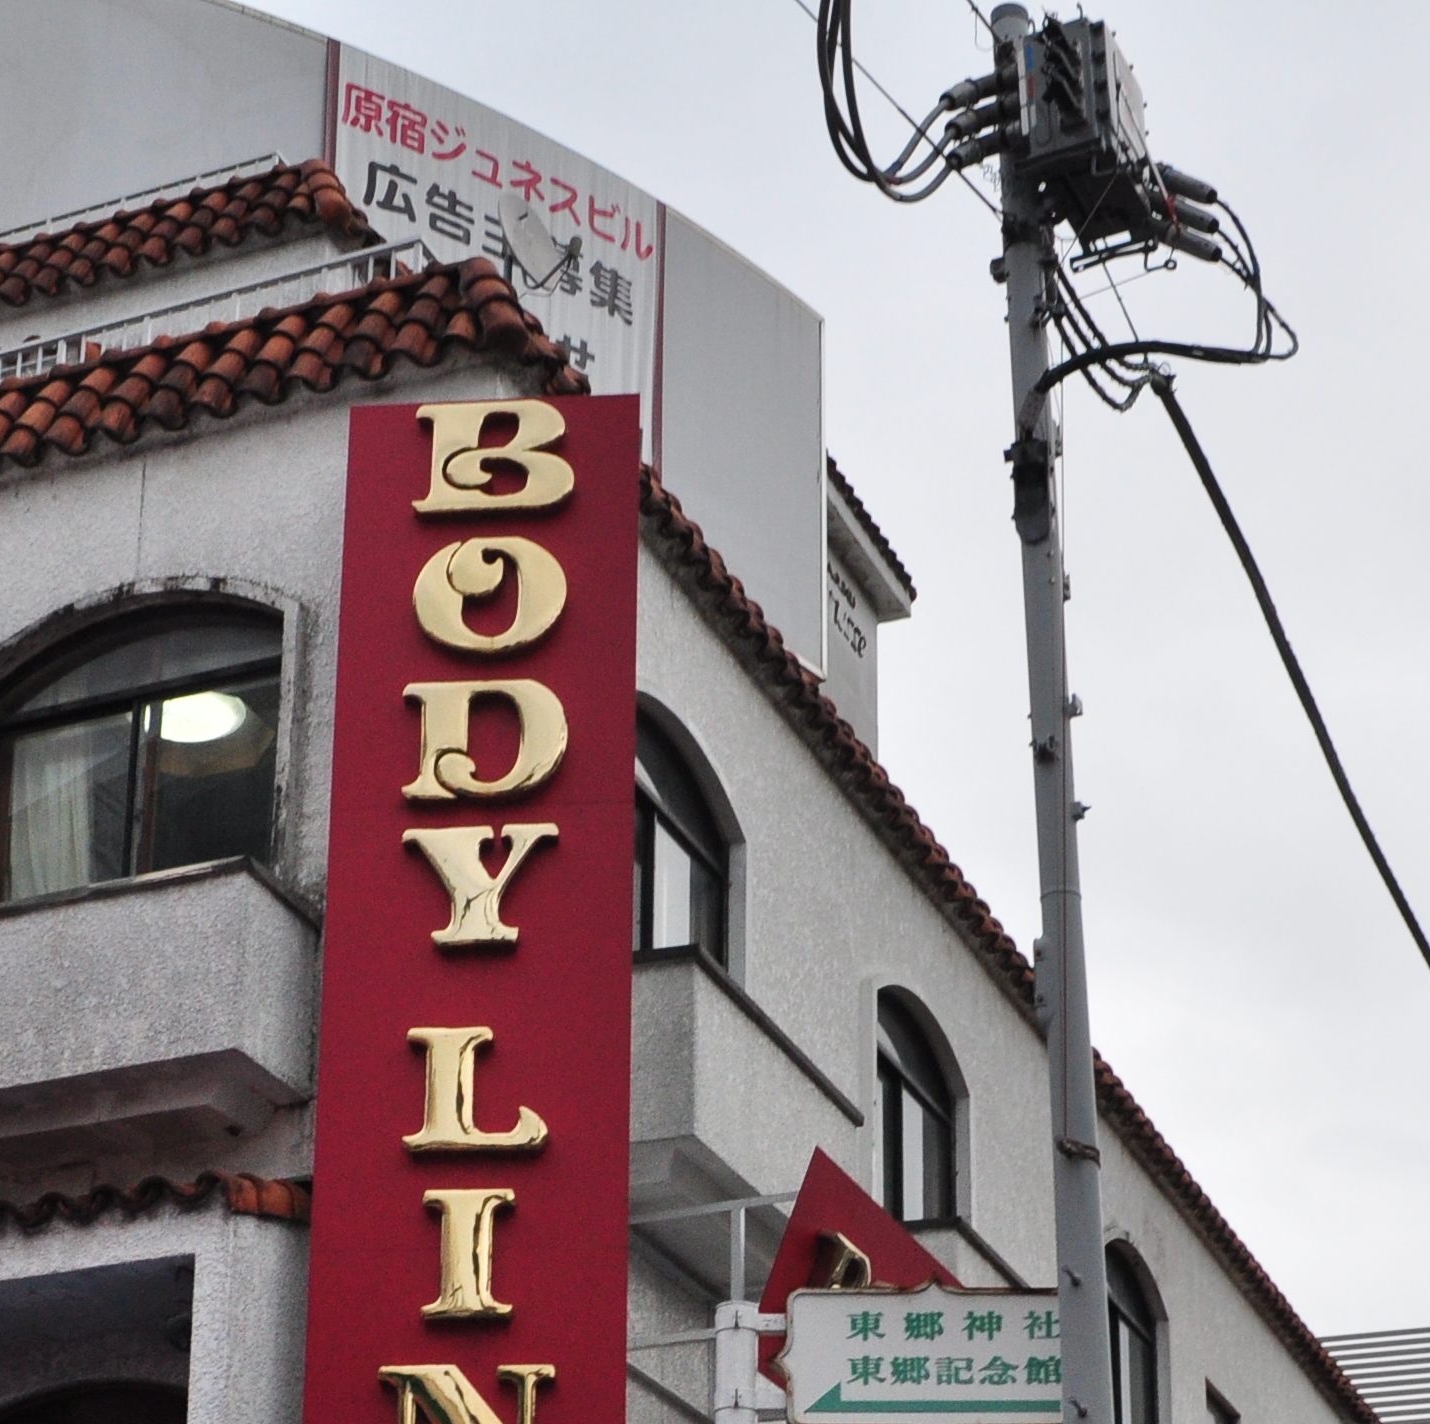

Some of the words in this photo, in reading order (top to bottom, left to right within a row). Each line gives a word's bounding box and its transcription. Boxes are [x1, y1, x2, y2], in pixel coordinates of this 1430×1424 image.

[341, 82, 654, 261] 原宿ジュネスビル
[401, 399, 575, 948] BODY
[845, 1310, 1060, 1341] 東郷神社
[845, 1355, 1064, 1387] 東郷記念館
